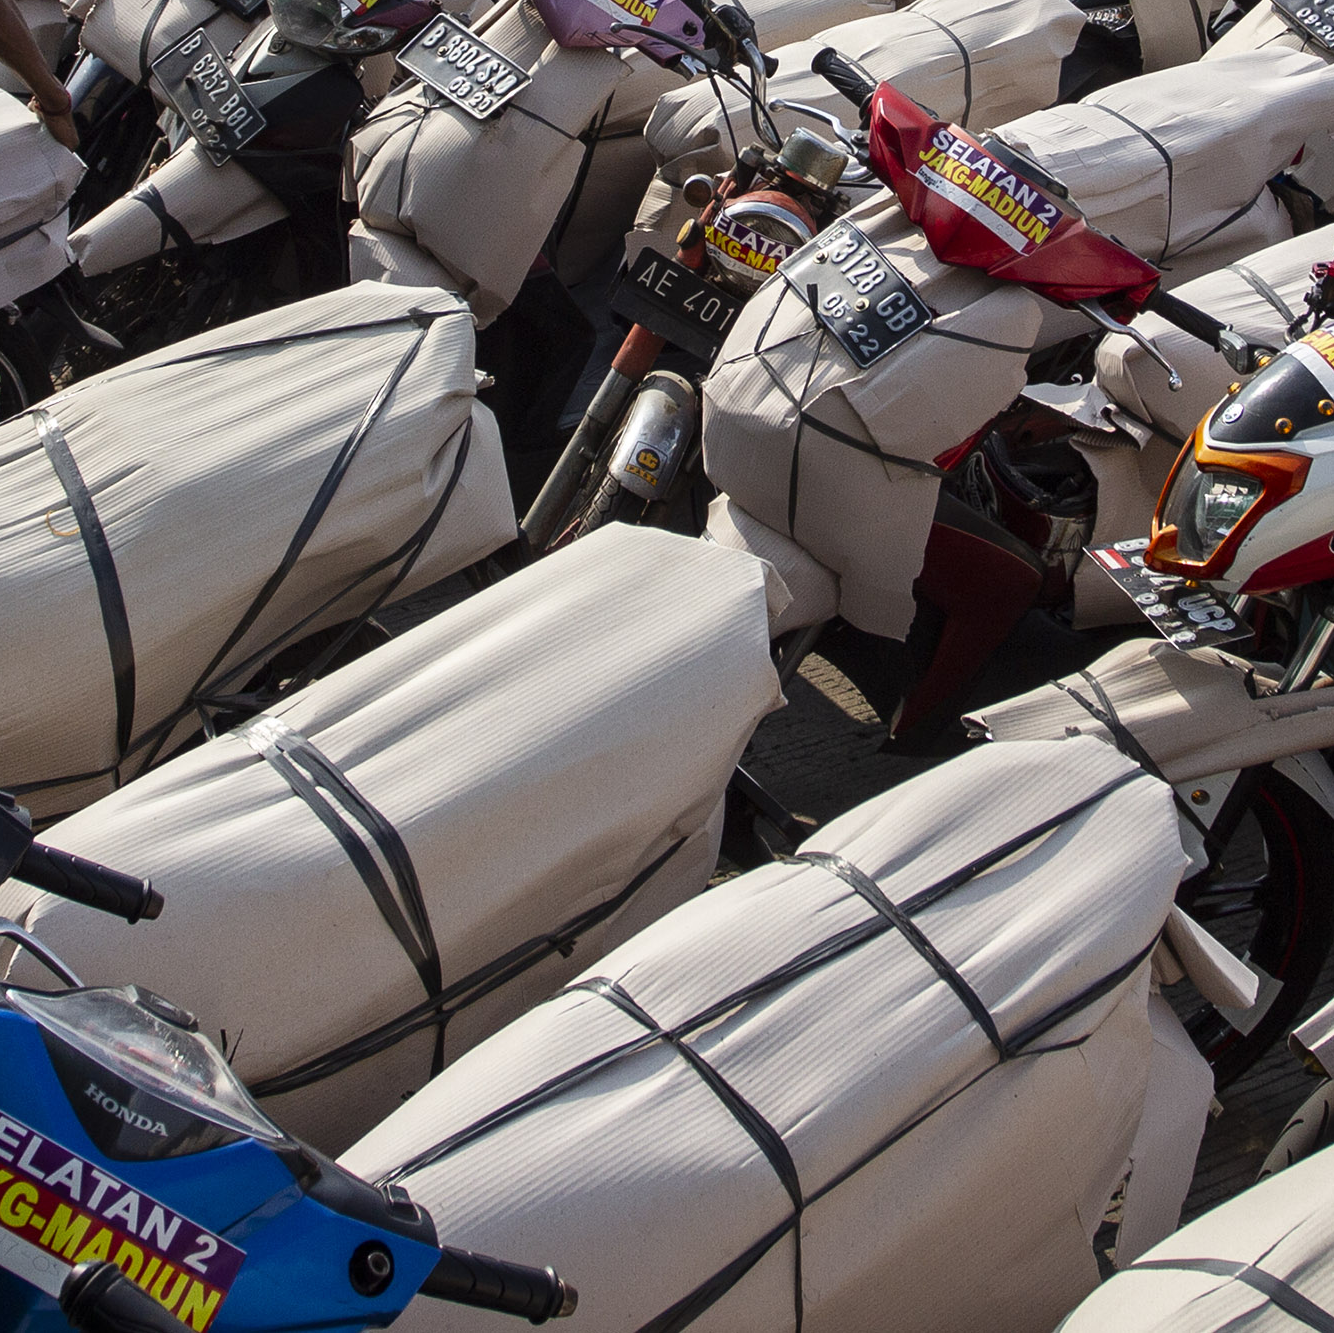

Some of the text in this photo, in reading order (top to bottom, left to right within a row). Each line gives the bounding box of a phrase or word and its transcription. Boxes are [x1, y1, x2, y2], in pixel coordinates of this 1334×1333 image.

[422, 22, 447, 49] B
[179, 36, 229, 104] B 6252
[918, 146, 1051, 245] JAKG-MADIUN
[932, 129, 1039, 210] SELATAN
[1036, 203, 1057, 226] 2
[715, 216, 800, 261] ELATA
[637, 260, 736, 332] AE 401
[830, 237, 918, 333] 3128 GB
[83, 1082, 169, 1139] HONDA
[181, 1234, 220, 1275] 2
